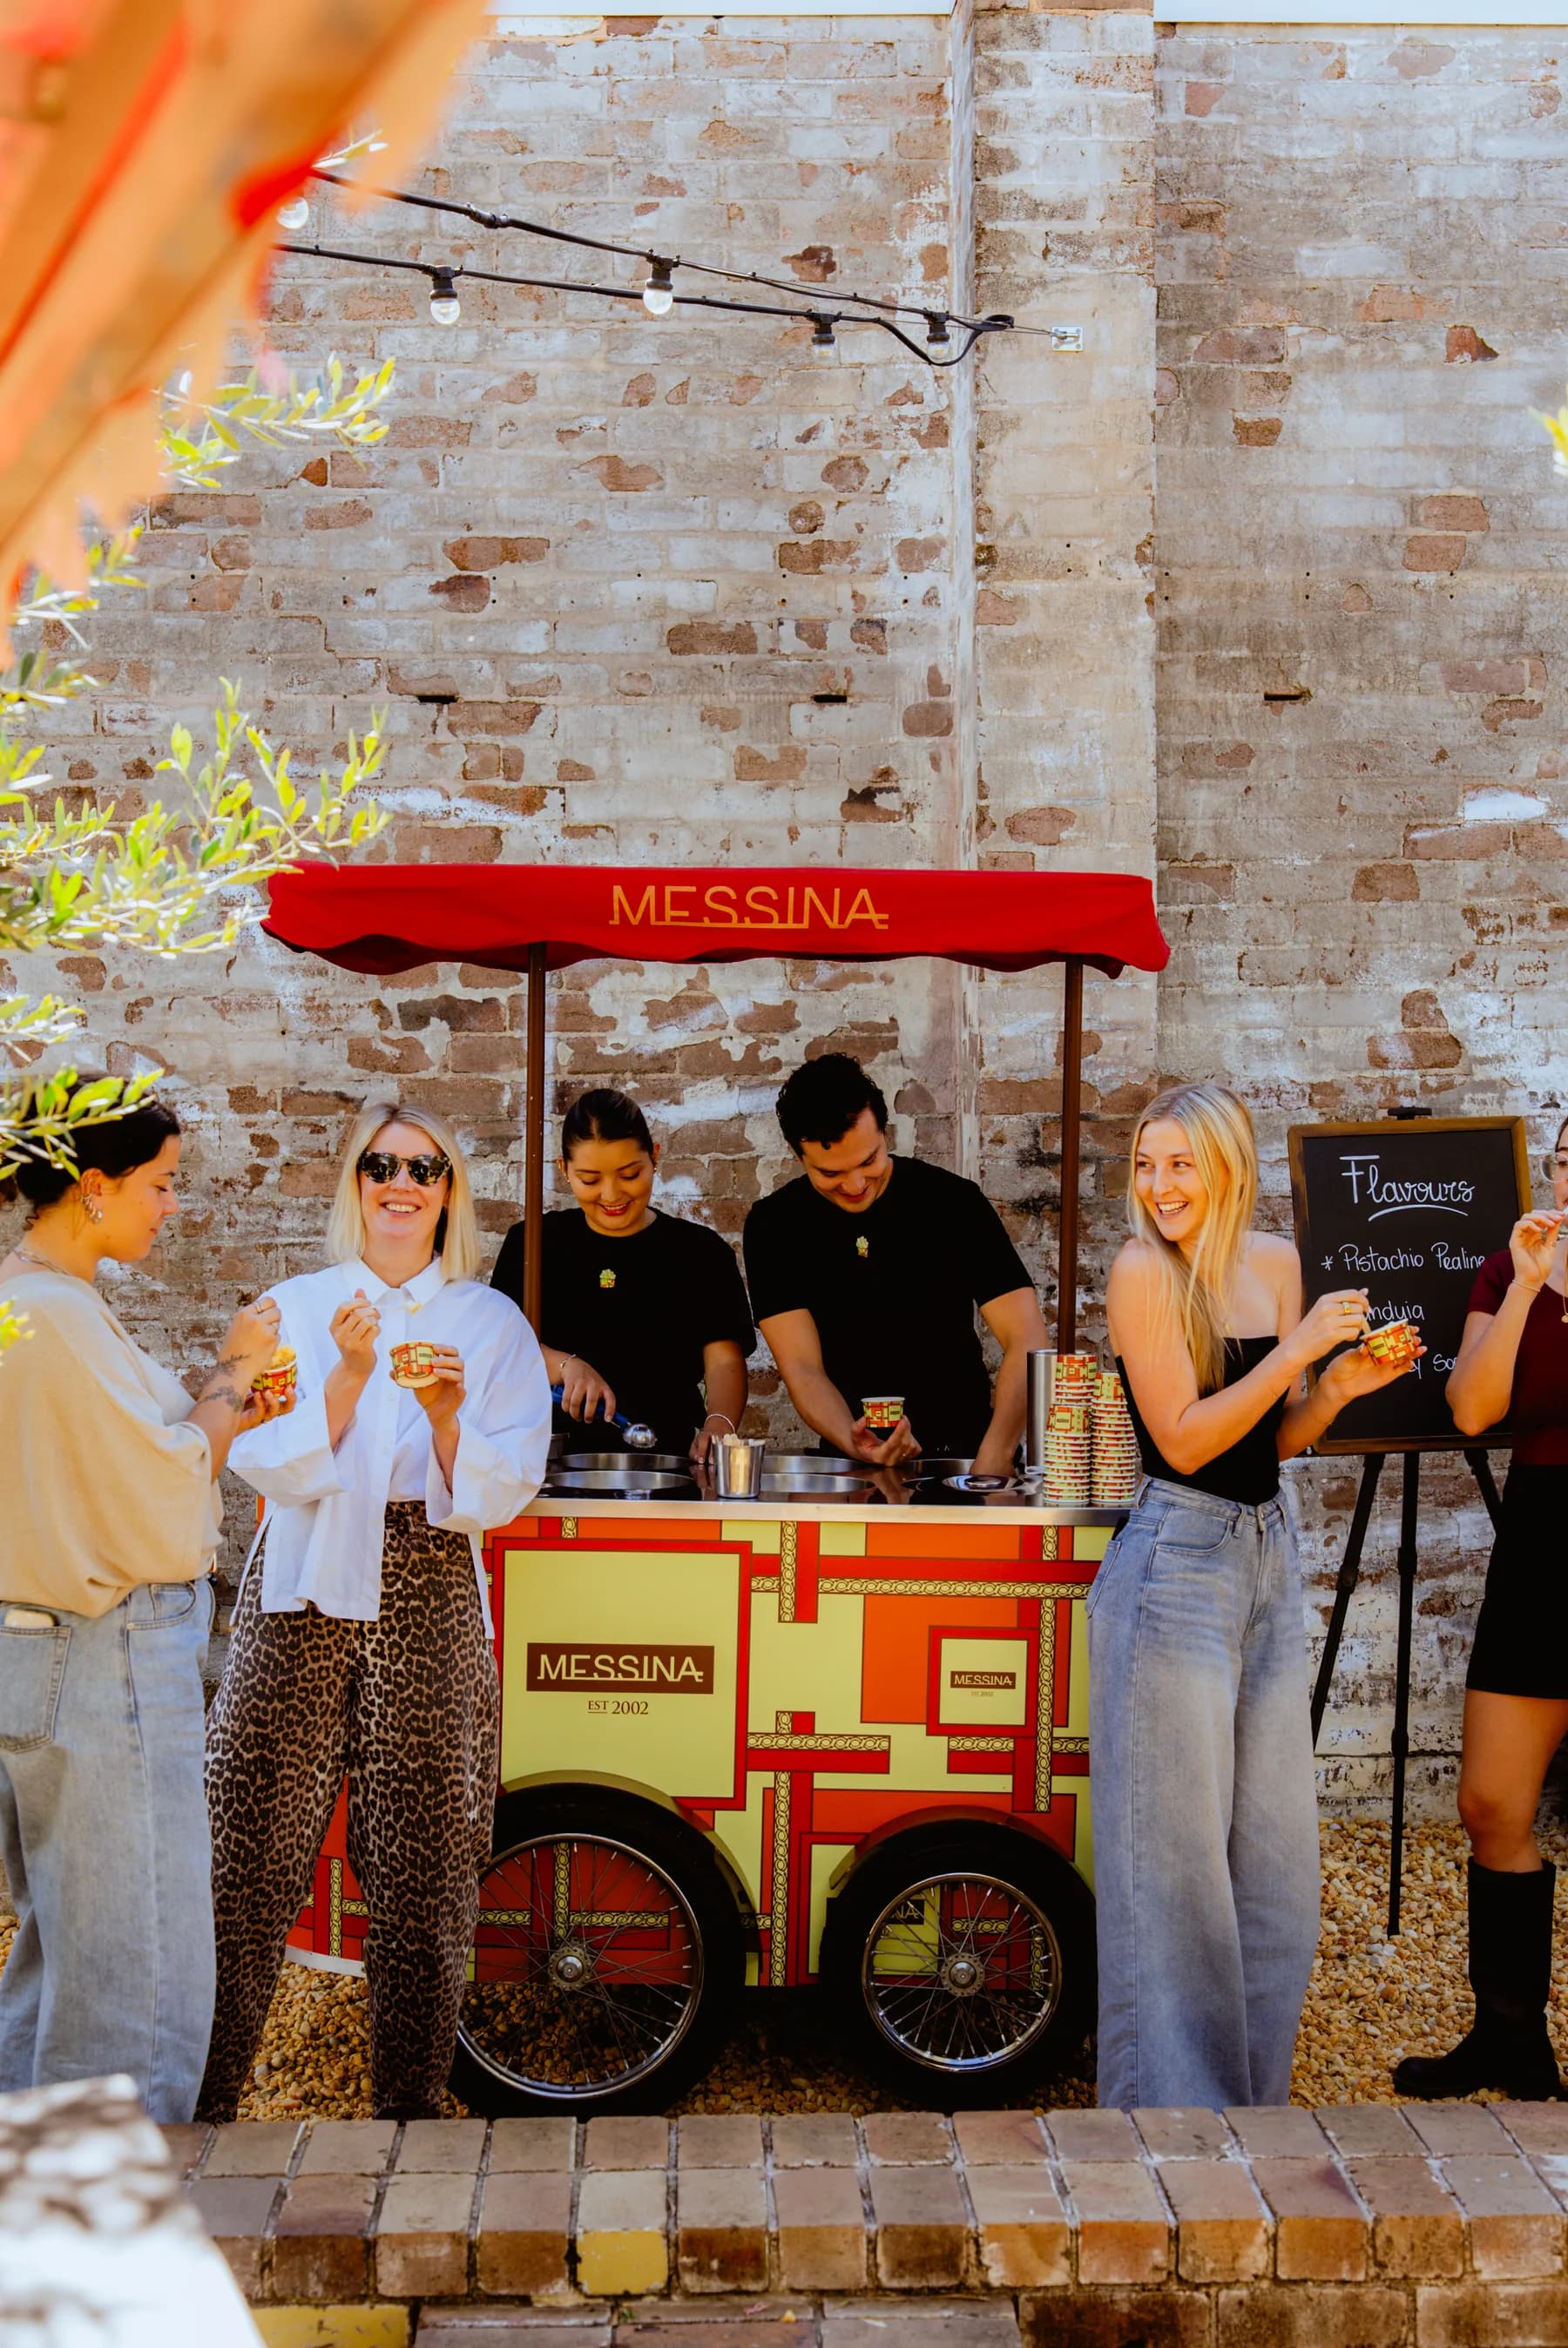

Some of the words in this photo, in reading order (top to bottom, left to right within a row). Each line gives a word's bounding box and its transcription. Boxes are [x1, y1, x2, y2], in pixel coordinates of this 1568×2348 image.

[609, 885, 889, 930] MESSINA
[1339, 1154, 1476, 1204] Flavours
[1338, 1243, 1424, 1272] Pistachio
[1366, 1300, 1425, 1322] nduia
[537, 1654, 704, 1682] MESSINA
[954, 1674, 1013, 1686] MESSINA
[588, 1700, 609, 1712] EST
[612, 1701, 649, 1715] 2002
